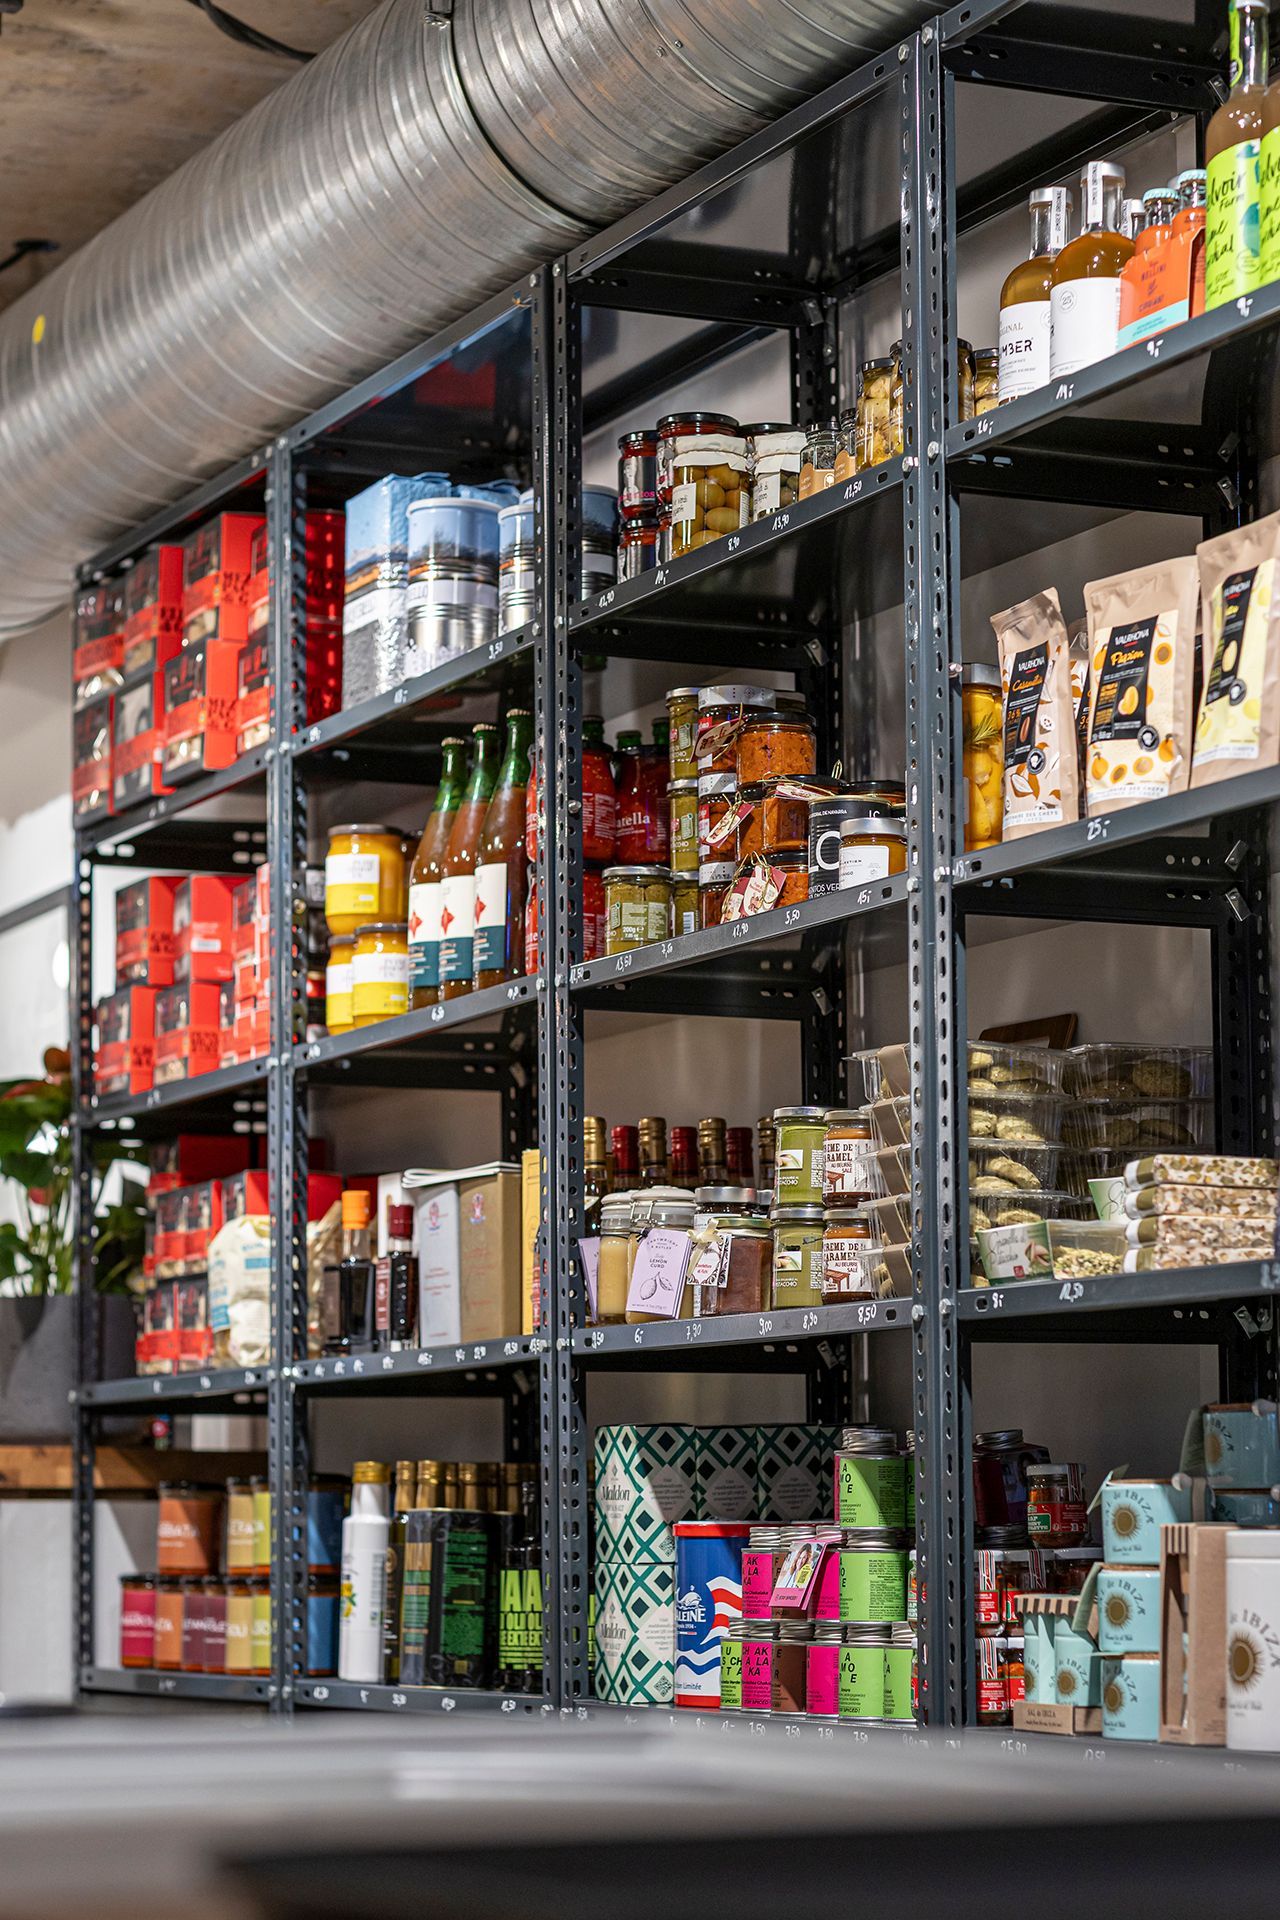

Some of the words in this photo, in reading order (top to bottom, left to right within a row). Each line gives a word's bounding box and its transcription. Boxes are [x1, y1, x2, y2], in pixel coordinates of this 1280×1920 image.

[1115, 628, 1149, 646] VALRHONA
[1019, 656, 1045, 672] VALRHONA
[843, 1143, 853, 1151] DE
[848, 1242, 858, 1250] DE
[858, 1303, 876, 1325] 8,50
[601, 1484, 630, 1501] Maldon
[1125, 1489, 1154, 1524] IBIZA
[748, 1567, 759, 1575] LA
[1118, 1579, 1146, 1616] IBIZA
[601, 1622, 627, 1641] Maldon
[754, 1647, 768, 1656] AK
[756, 1658, 769, 1666] LA
[748, 1667, 761, 1676] KA
